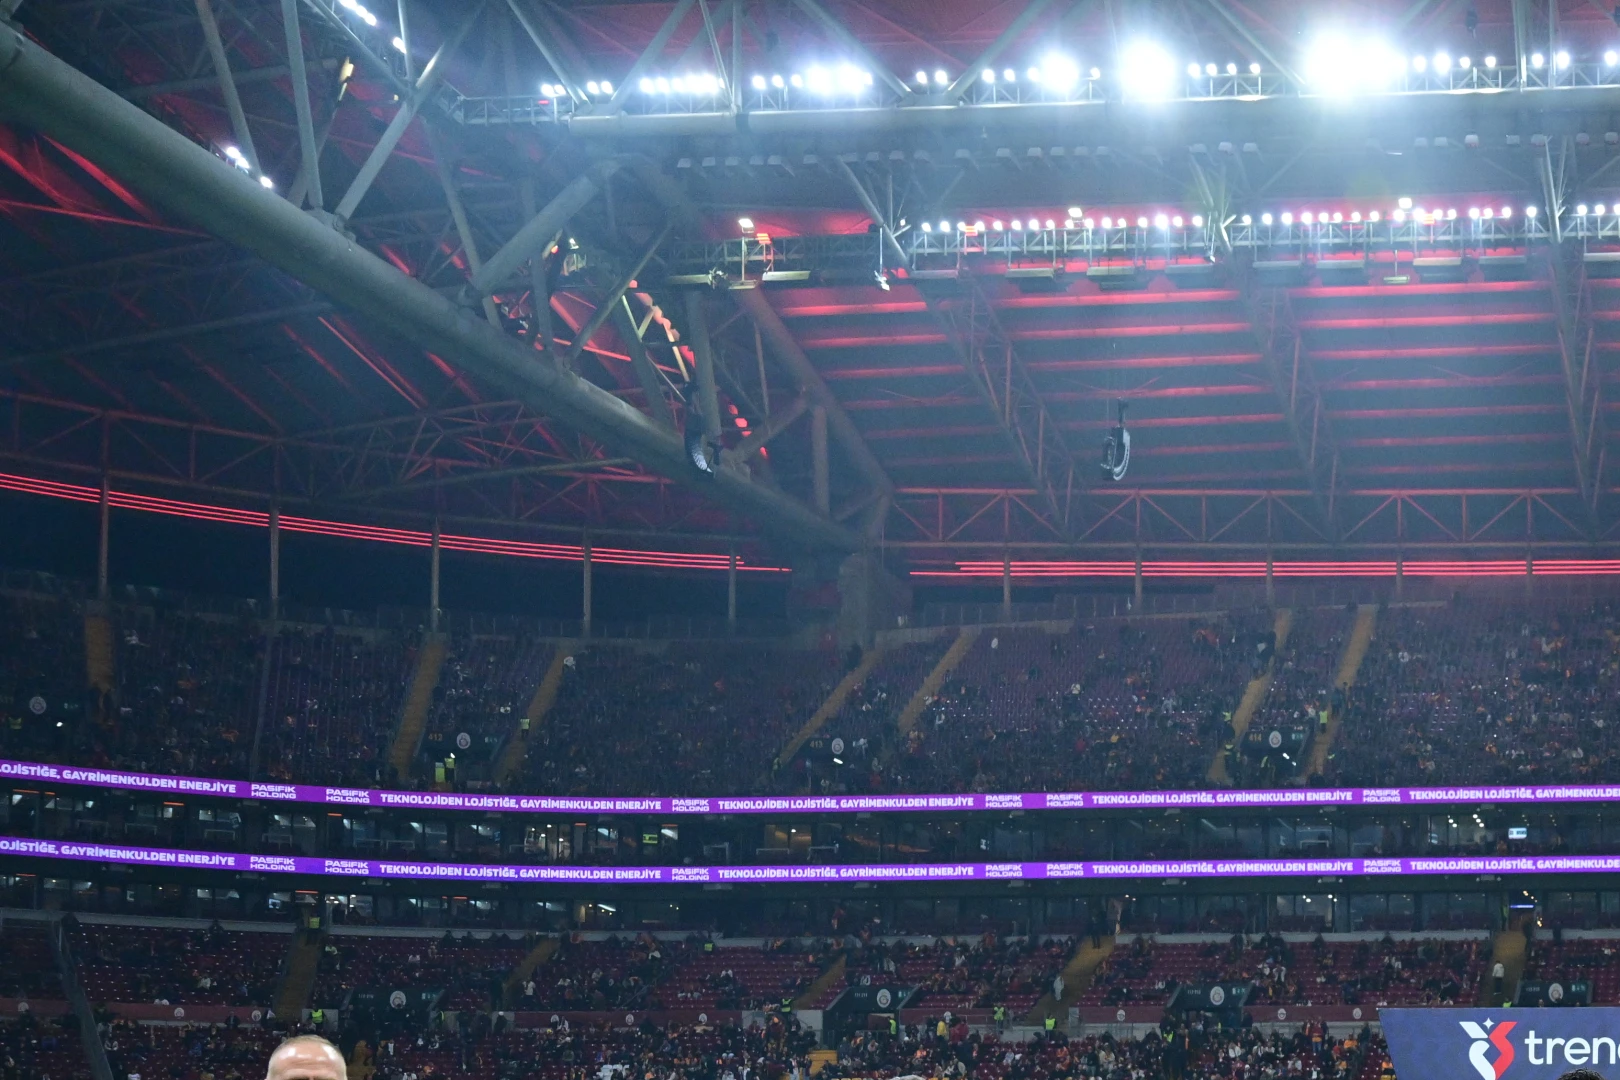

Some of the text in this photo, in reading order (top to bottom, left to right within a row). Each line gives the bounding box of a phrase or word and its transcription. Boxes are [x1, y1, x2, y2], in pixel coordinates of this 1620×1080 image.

[63, 770, 176, 787] GAYRİMENKULDEN
[179, 780, 236, 793] ENERJİYE
[1092, 794, 1164, 804] TEKNOLOJİDEN
[1216, 792, 1305, 802] GAYRİMENKULDEN
[1306, 791, 1352, 801] ENERJİYE
[1409, 790, 1483, 799] TEKNOLOJİDEN
[380, 794, 462, 805] TEKNOLOJİDEN
[520, 799, 614, 809] GAYRİMENKULDEN
[616, 800, 661, 809] ENERJİYE
[718, 800, 789, 809] TEKNOLOJİDEN
[840, 798, 927, 808] GAYRİMENKULDEN
[929, 797, 974, 806] ENERJİYE
[61, 846, 175, 861] GAYRİMENKULDEN
[178, 854, 235, 865] ENERJİYE
[1092, 864, 1165, 873] TEKNOLOJİDEN
[1217, 863, 1306, 872] GAYRİMENKULDEN
[1307, 861, 1353, 871] ENERJİYE
[1410, 860, 1484, 870] TEKNOLOJİDEN
[380, 865, 462, 875] TEKNOLOJİDEN
[520, 869, 613, 879] GAYRİMENKULDEN
[615, 869, 661, 879] ENERJİYE
[718, 869, 789, 878] TEKNOLOJİDEN
[840, 868, 927, 877] GAYRİMENKULDEN
[929, 866, 974, 876] ENERJİYE
